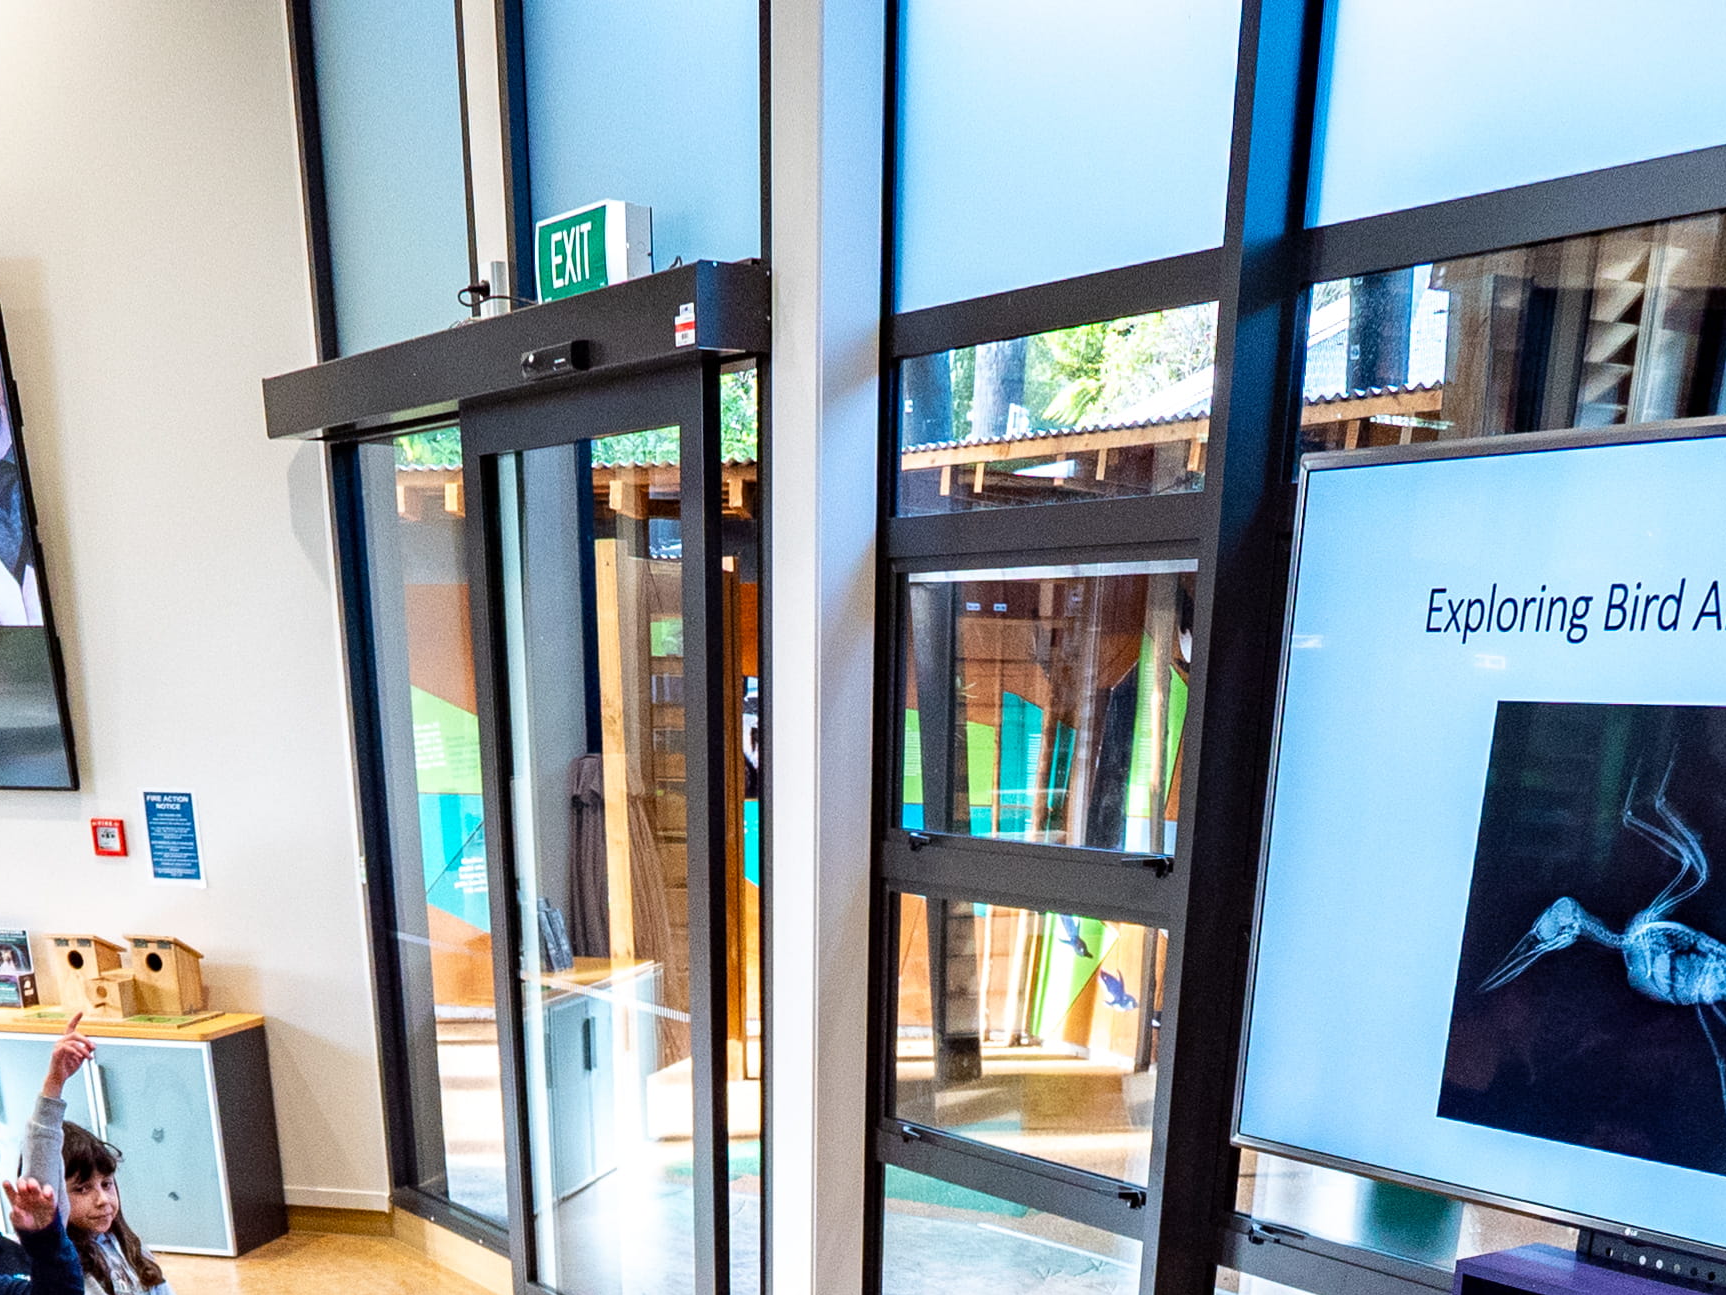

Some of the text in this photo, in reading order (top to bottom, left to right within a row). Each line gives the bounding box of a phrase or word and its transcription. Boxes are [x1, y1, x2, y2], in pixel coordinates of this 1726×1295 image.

[551, 221, 592, 289] EXIT
[1425, 584, 1594, 644] Exploring
[1602, 578, 1687, 632] Bird
[163, 795, 189, 803] ACTION
